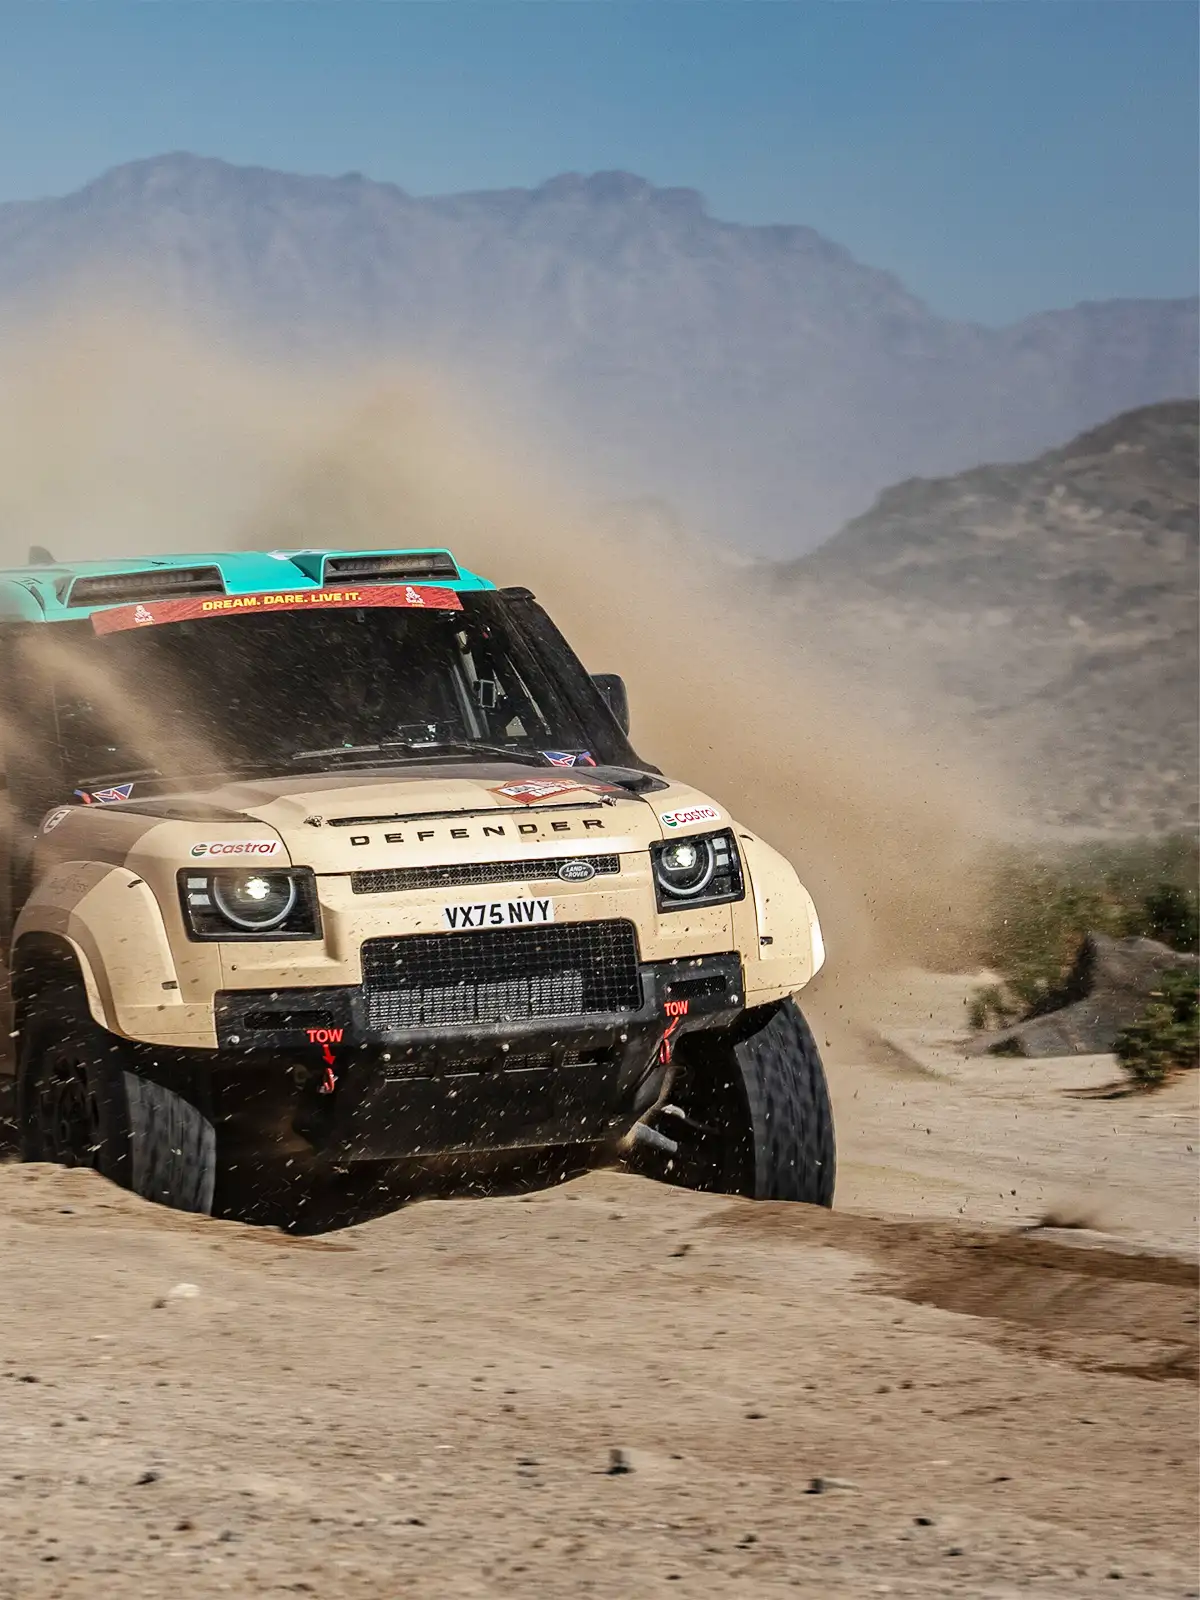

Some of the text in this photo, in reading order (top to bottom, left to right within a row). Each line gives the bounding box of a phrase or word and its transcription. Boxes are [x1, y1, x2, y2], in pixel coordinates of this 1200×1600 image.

[202, 592, 362, 611] DREAM. DARE. LIVE IT.
[674, 808, 718, 823] Castrol
[350, 818, 606, 846] DEFENDER
[209, 842, 277, 855] Castrol
[445, 900, 550, 929] VX75 NVY
[663, 1000, 689, 1017] TOW
[307, 1028, 344, 1044] TOW
